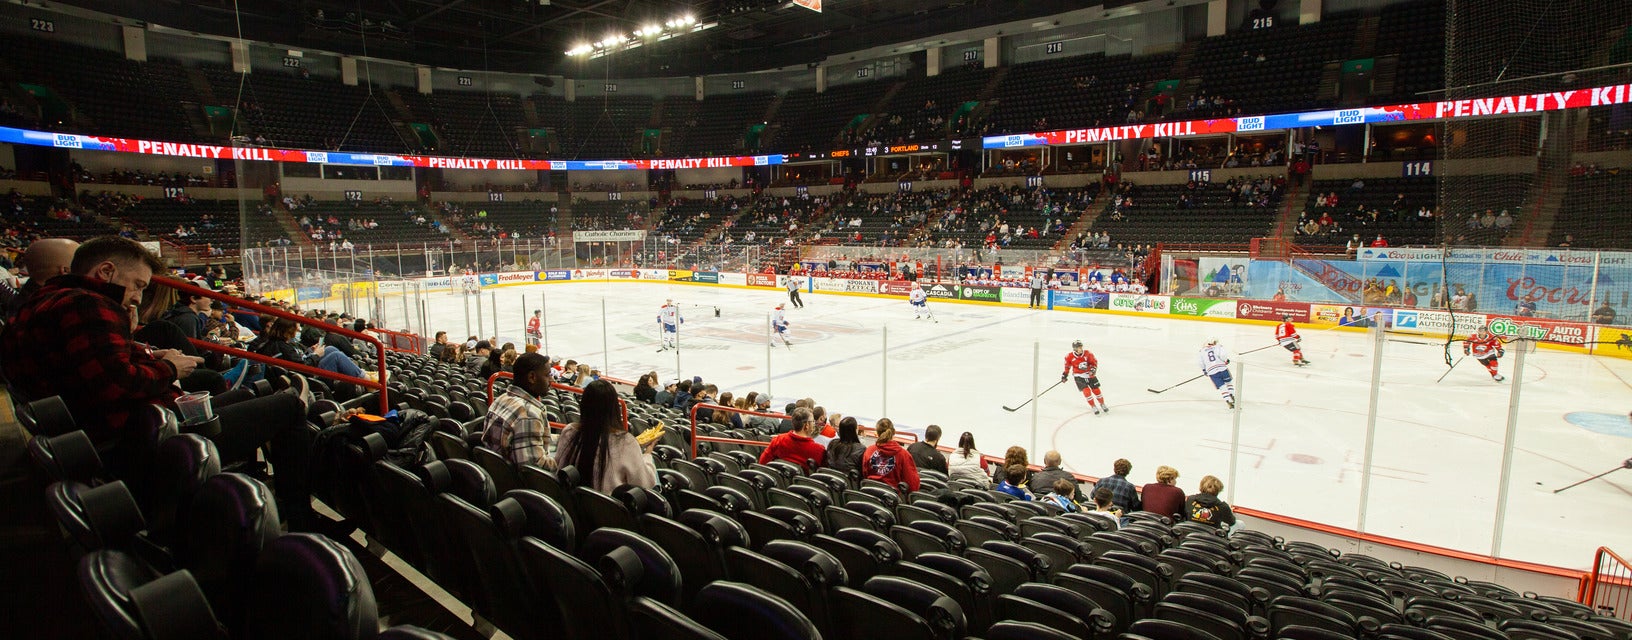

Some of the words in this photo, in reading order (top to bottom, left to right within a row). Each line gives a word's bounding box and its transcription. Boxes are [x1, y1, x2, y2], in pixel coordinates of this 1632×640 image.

[32, 19, 54, 32] 223
[1253, 17, 1273, 29] 215
[965, 51, 977, 60] 217
[284, 58, 299, 67] 222
[459, 77, 471, 86] 221
[1436, 90, 1576, 118] PENALTY
[1339, 109, 1360, 117] BUD
[1335, 115, 1363, 123] LIGHT
[1066, 125, 1146, 143] PENALTY
[1154, 121, 1196, 137] KILL
[138, 140, 224, 158] PENALTY
[232, 147, 273, 161] KILL
[890, 144, 919, 153] PORTLAND
[831, 150, 849, 158] CHIEFS
[429, 157, 490, 169] PENALTY
[496, 159, 526, 169] KILL
[650, 158, 701, 169] PENALTY
[707, 157, 733, 168] KILL
[1407, 162, 1430, 175] 114
[1191, 170, 1209, 182] 115
[900, 182, 911, 191] 117
[346, 191, 362, 200] 122
[490, 193, 503, 201] 121
[1559, 253, 1592, 263] Coors
[1506, 277, 1598, 305] Coors
[1419, 312, 1451, 321] PACIFIC
[1453, 315, 1483, 324] OFFICE
[1419, 320, 1477, 330] AUTOMATION
[1489, 320, 1549, 339] O'Rlly
[1552, 326, 1581, 335] AUTO
[1548, 334, 1584, 344] PARTS
[1207, 350, 1216, 362] 8
